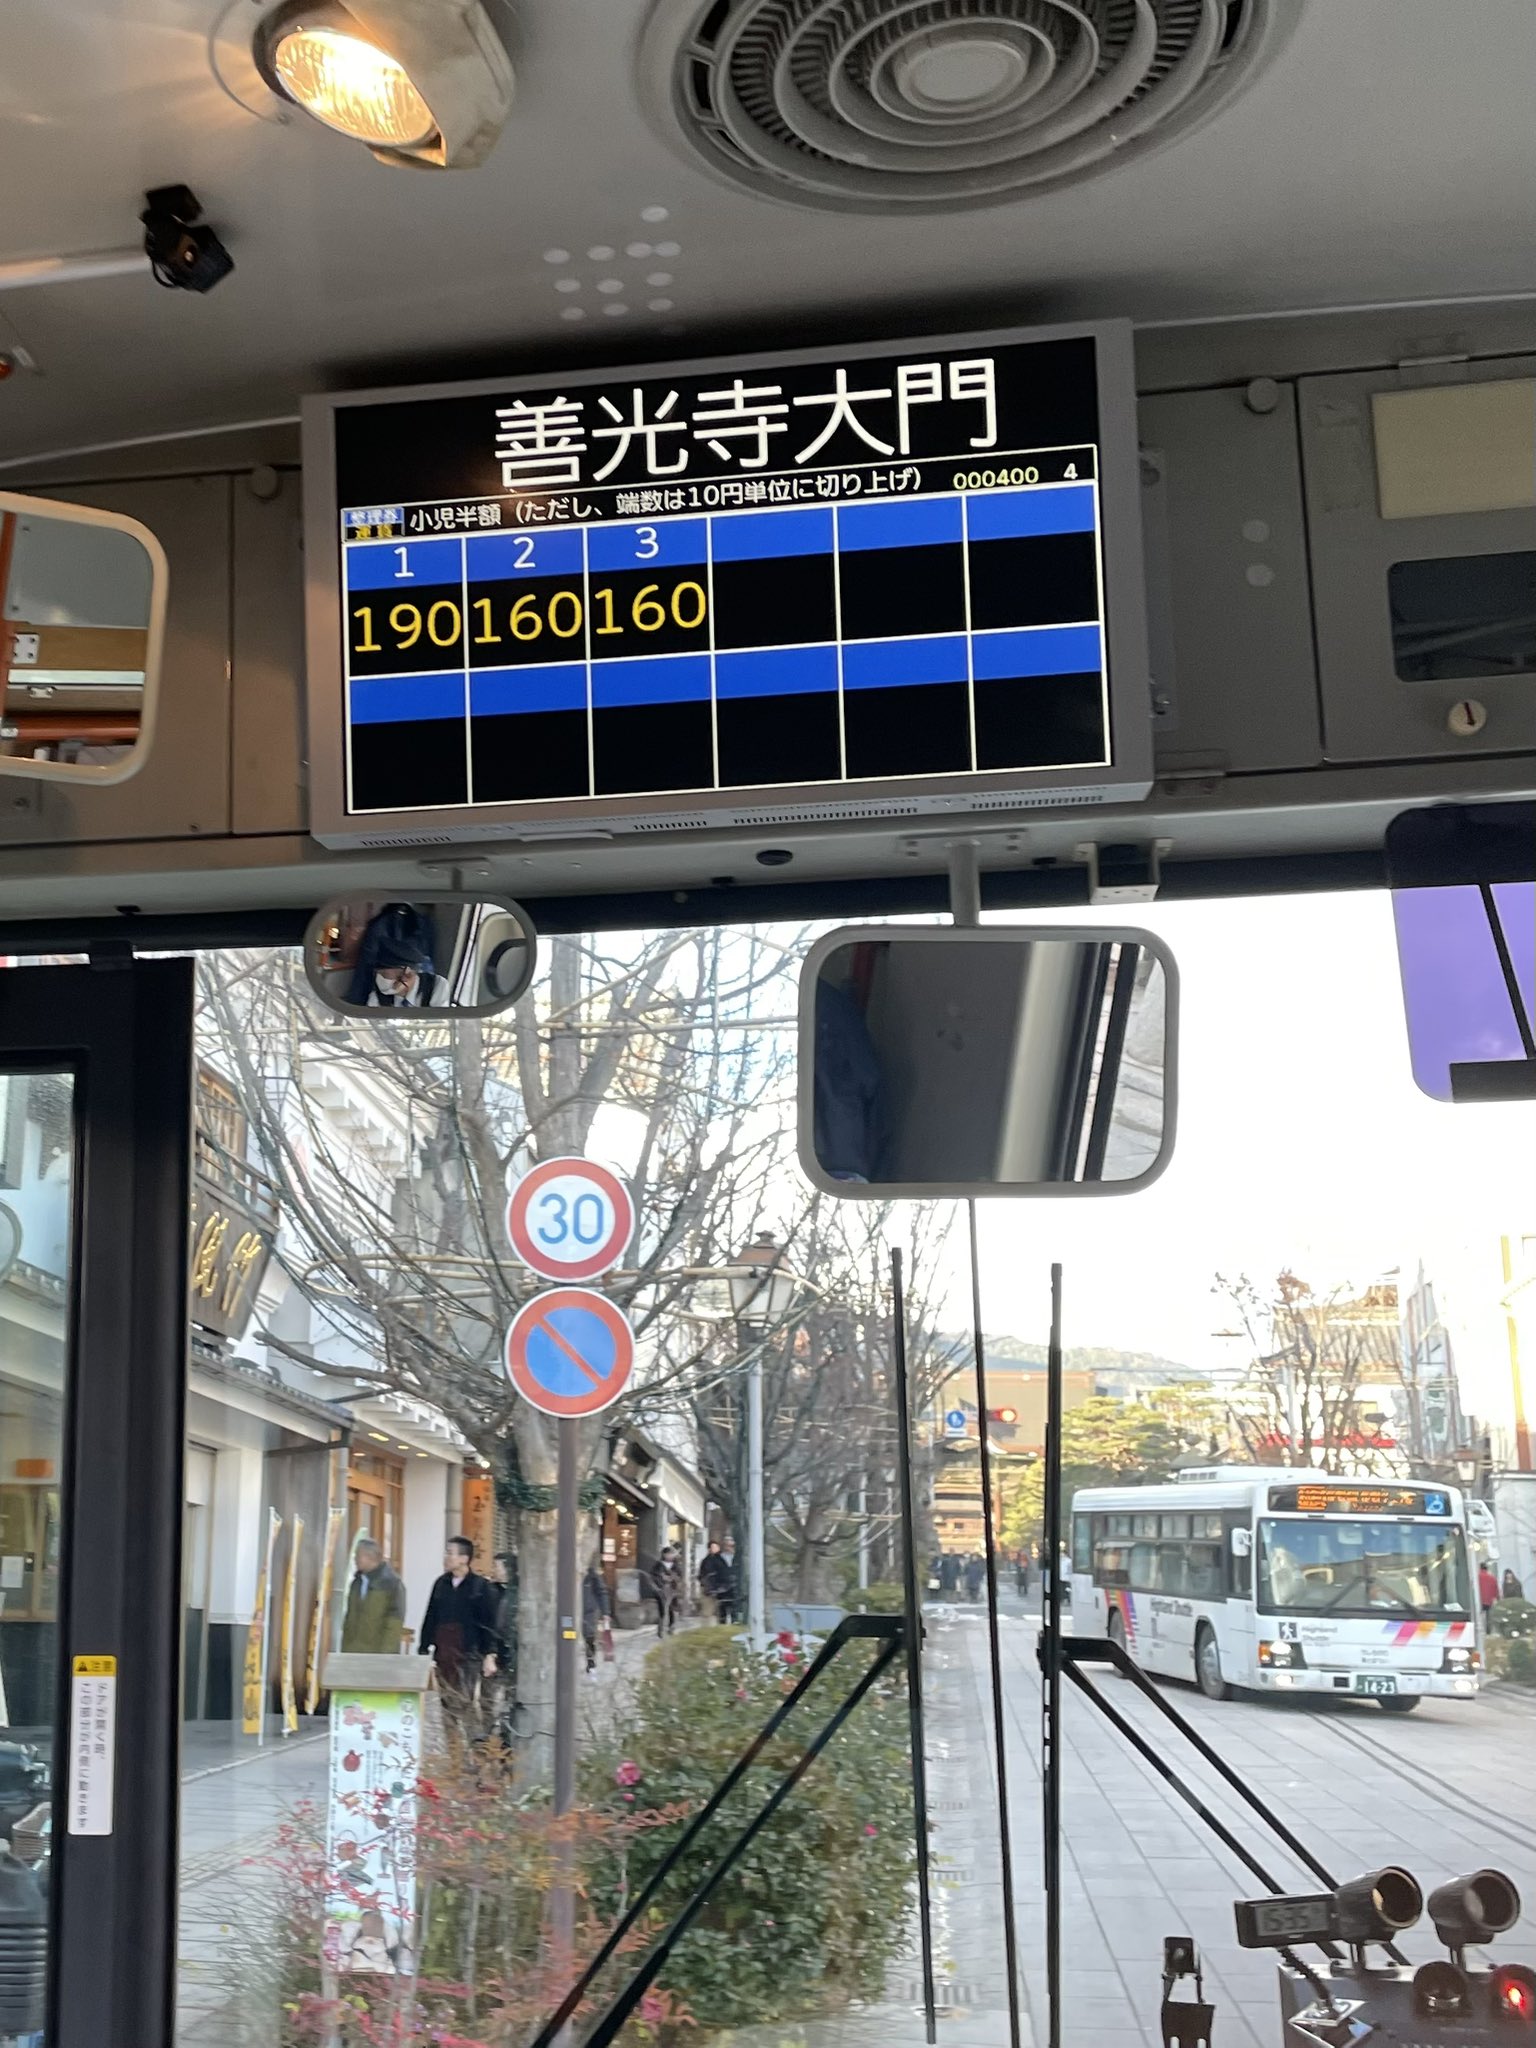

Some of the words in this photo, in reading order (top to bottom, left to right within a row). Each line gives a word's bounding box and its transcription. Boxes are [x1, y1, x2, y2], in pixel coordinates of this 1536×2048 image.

[494, 358, 998, 488] 善光寺大門
[952, 466, 1040, 490] 000400
[1063, 462, 1078, 480] 4
[392, 546, 415, 578] 1
[512, 536, 536, 569] 2
[634, 526, 660, 559] 3
[353, 600, 462, 653] 190
[472, 591, 583, 644] 160
[594, 581, 707, 635] 160
[537, 1193, 604, 1245] 30
